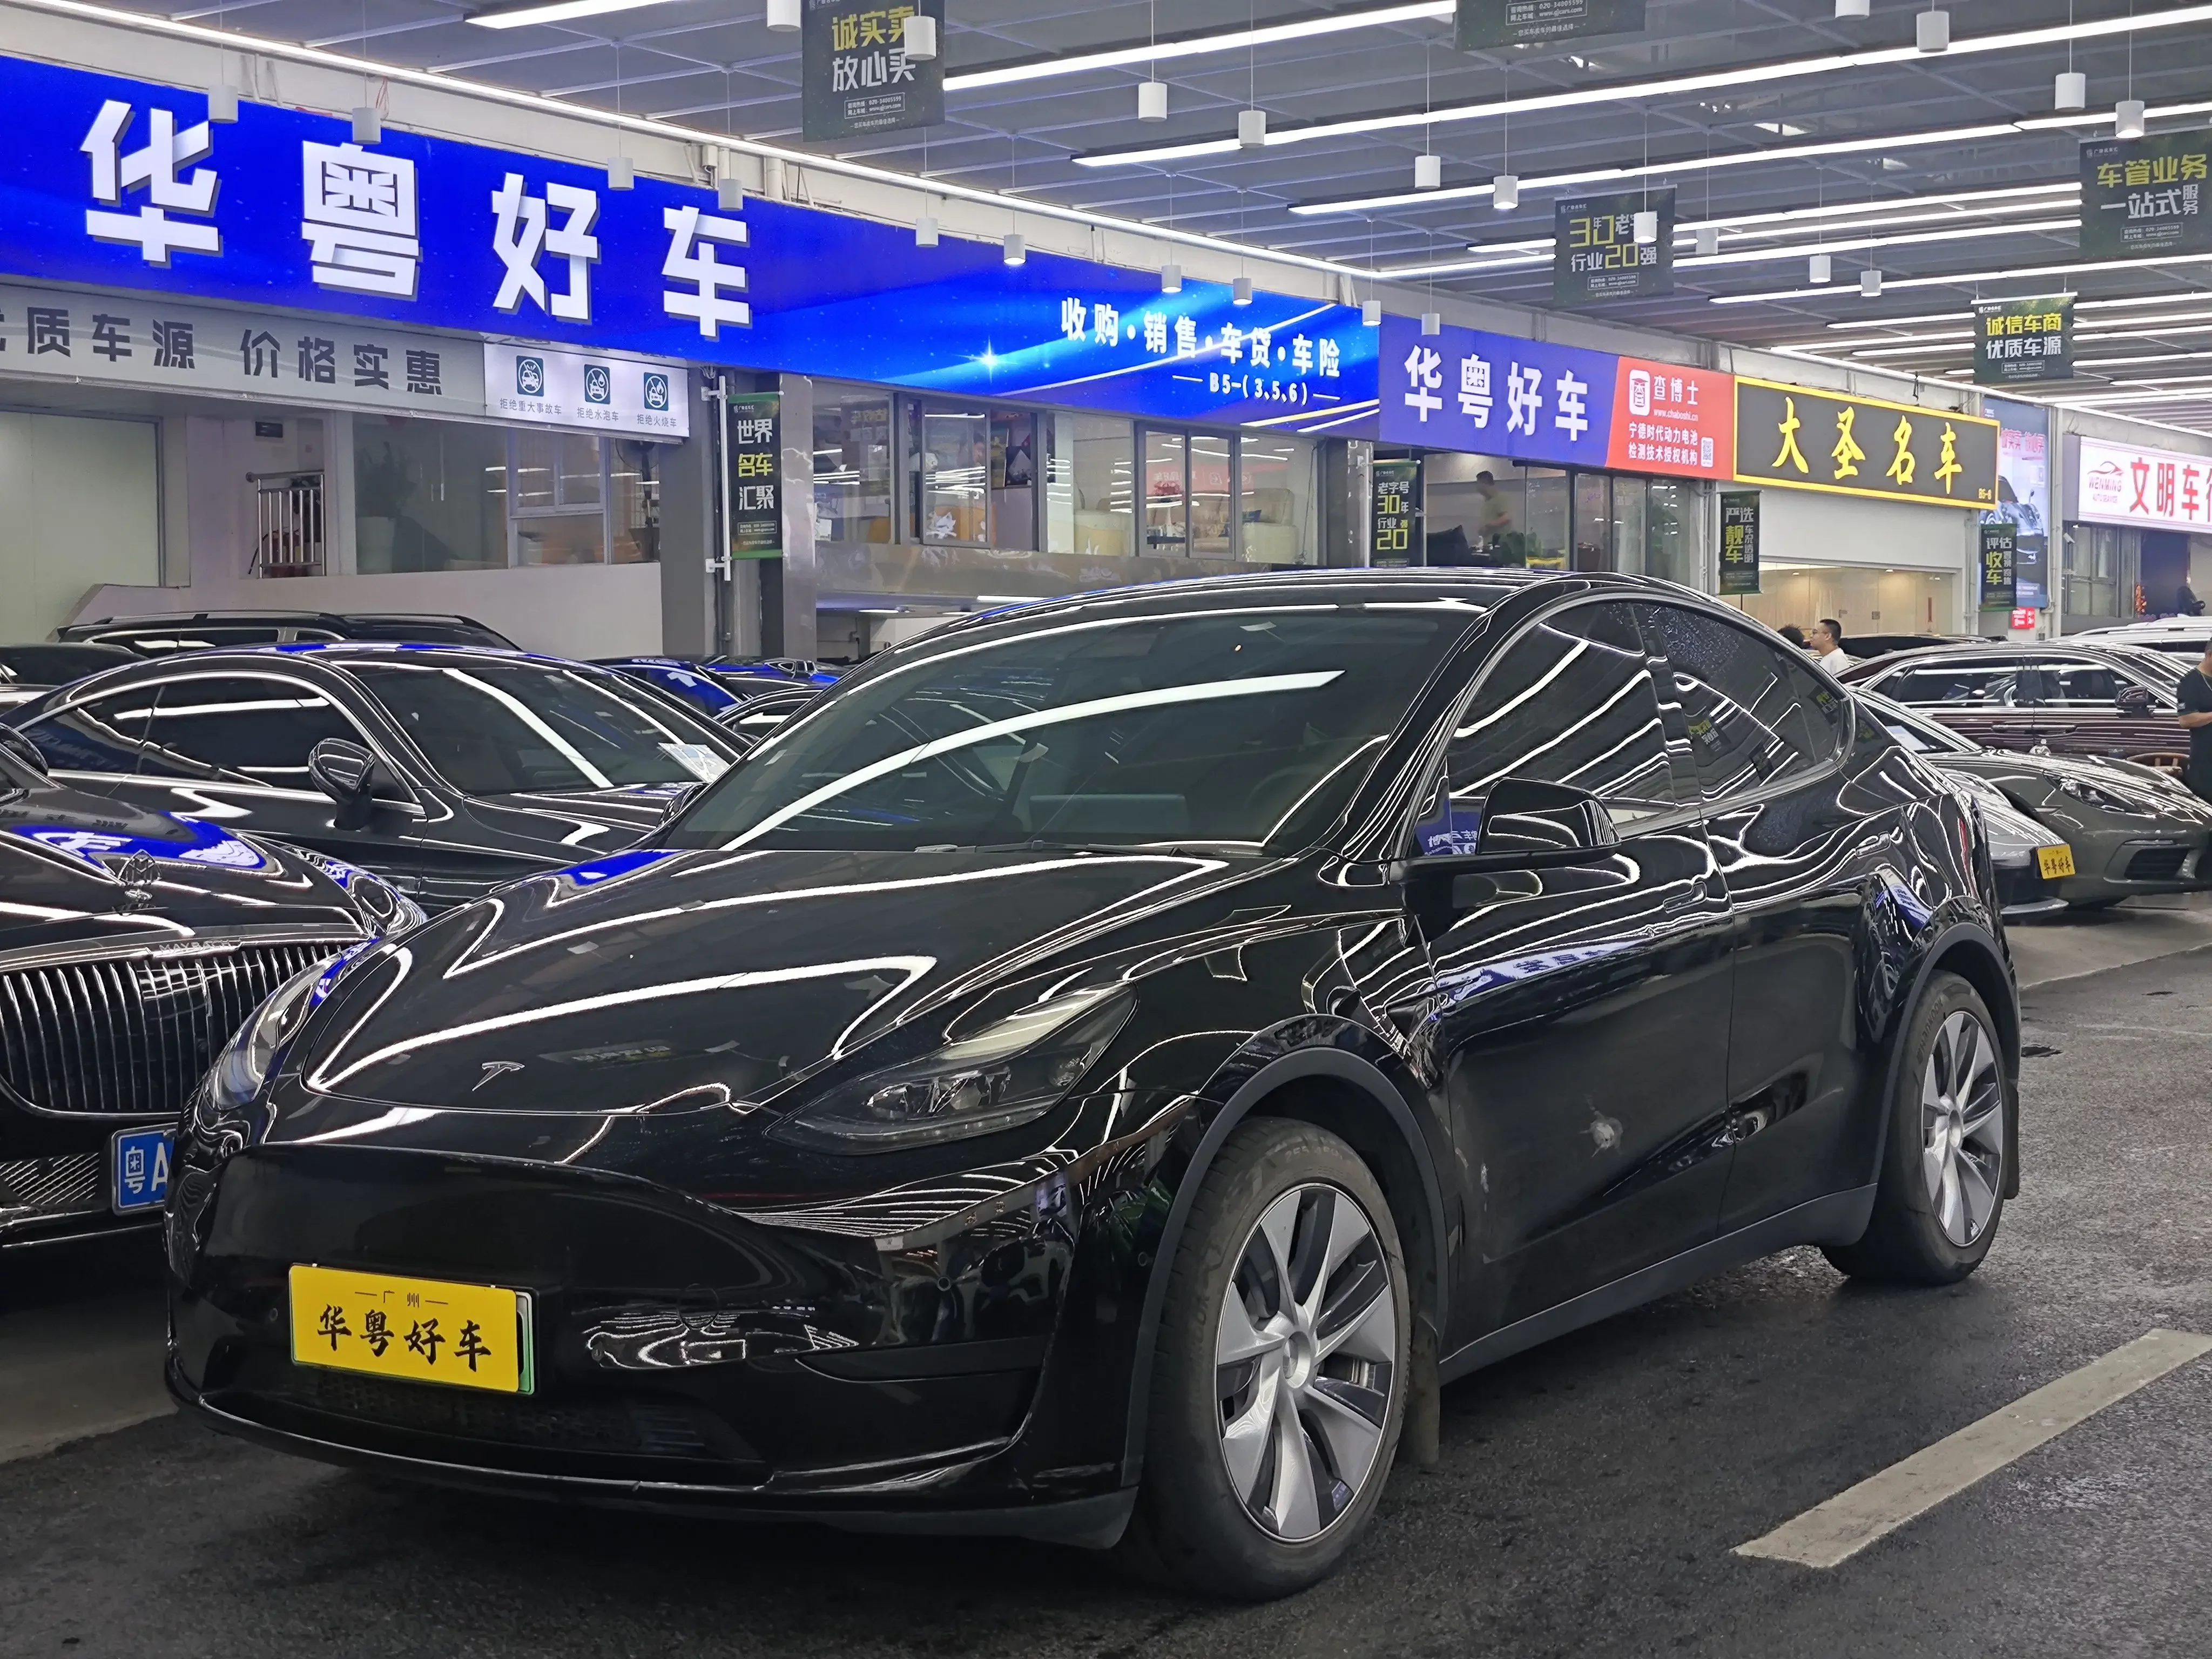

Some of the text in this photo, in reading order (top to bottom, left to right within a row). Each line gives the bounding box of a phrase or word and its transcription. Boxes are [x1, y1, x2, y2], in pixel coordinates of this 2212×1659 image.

[832, 48, 915, 92] 放心买
[2098, 154, 2207, 188] 车管业务
[79, 99, 750, 338] 华粤好车
[1986, 313, 2062, 336] 诚信车商
[0, 307, 442, 395] 质车源 价格实惠
[1986, 336, 2062, 359] 优质车源
[1404, 345, 1588, 442] 华粤好车
[1654, 375, 1699, 405] 查博士
[500, 398, 677, 427] 拒绝重大事故车 拒绝水泡车 拒绝火烧车
[738, 418, 773, 444] 世界
[1629, 422, 1698, 446] 宁德时代动力电池
[1628, 442, 1697, 466] 检测技术授权机构
[1772, 396, 1963, 495] 大圣名车
[738, 453, 773, 477] 名车
[739, 485, 774, 510] 汇聚
[1378, 481, 1409, 494] 老字号
[2130, 457, 2212, 522] 文明车
[1378, 517, 1397, 529] 行业
[1725, 507, 1754, 523] 严选
[1377, 529, 1408, 550] 20
[1725, 525, 1744, 563] 靓车
[1986, 537, 2012, 549] 评估
[1986, 551, 2003, 585] 收车
[383, 1290, 420, 1309] 广州
[317, 1303, 492, 1373] 华粤好车
